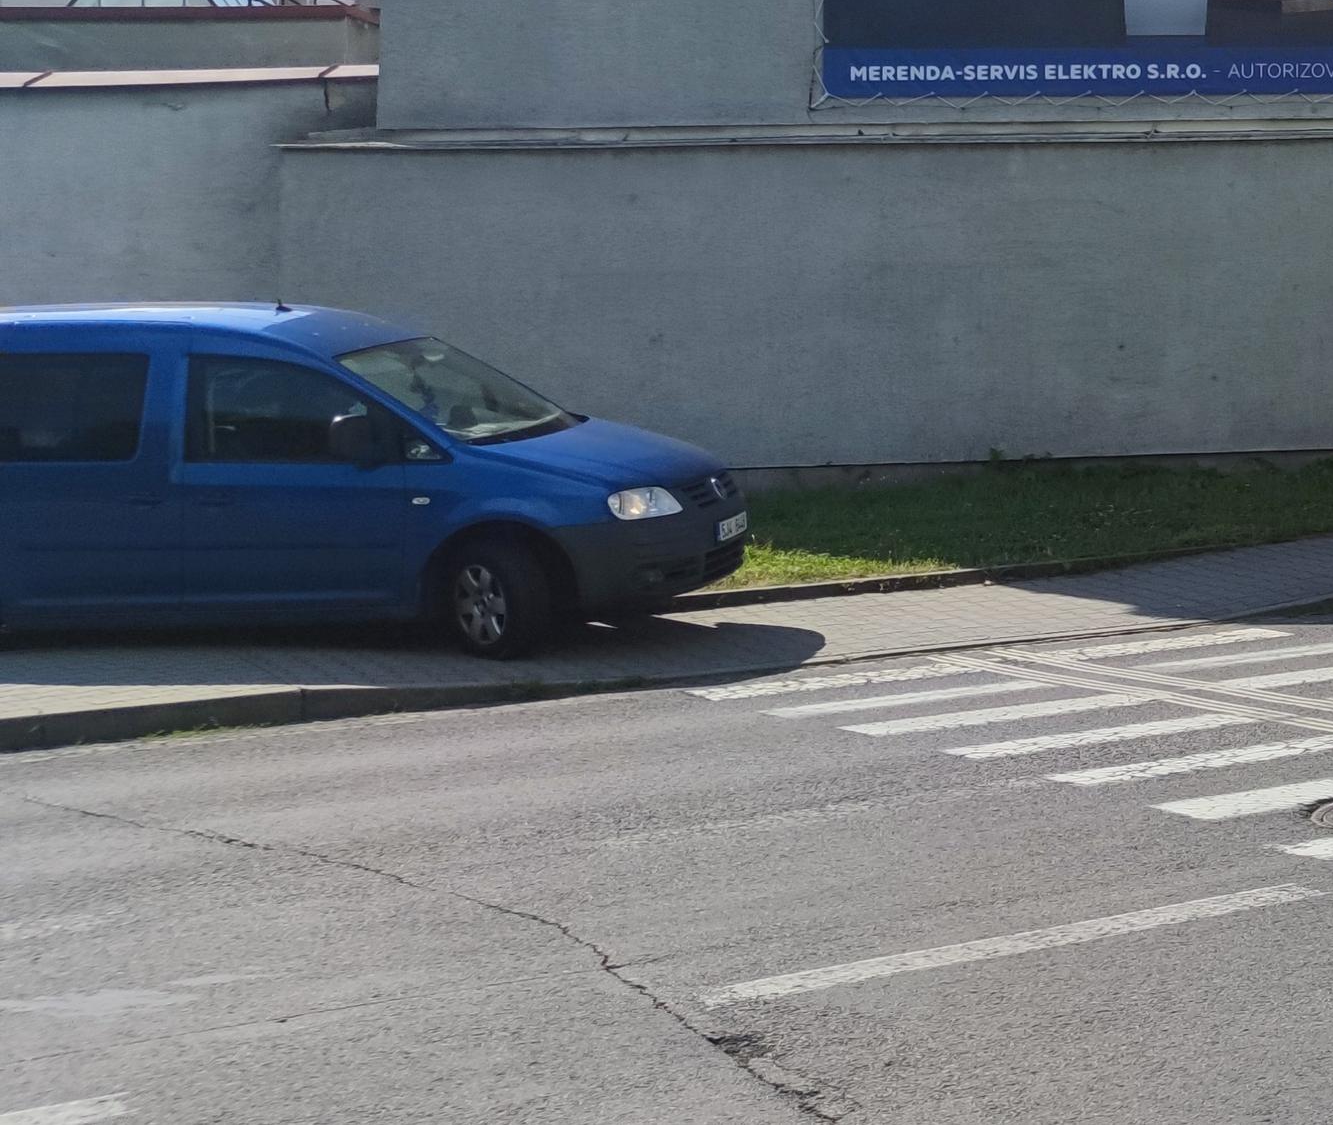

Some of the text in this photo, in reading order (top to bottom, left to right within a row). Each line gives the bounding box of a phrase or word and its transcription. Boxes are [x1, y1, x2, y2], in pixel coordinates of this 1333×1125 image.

[850, 64, 1038, 82] MERENDA-SERVIS
[1044, 64, 1141, 81] ELEKTRO
[1147, 63, 1207, 80] S.R.O.
